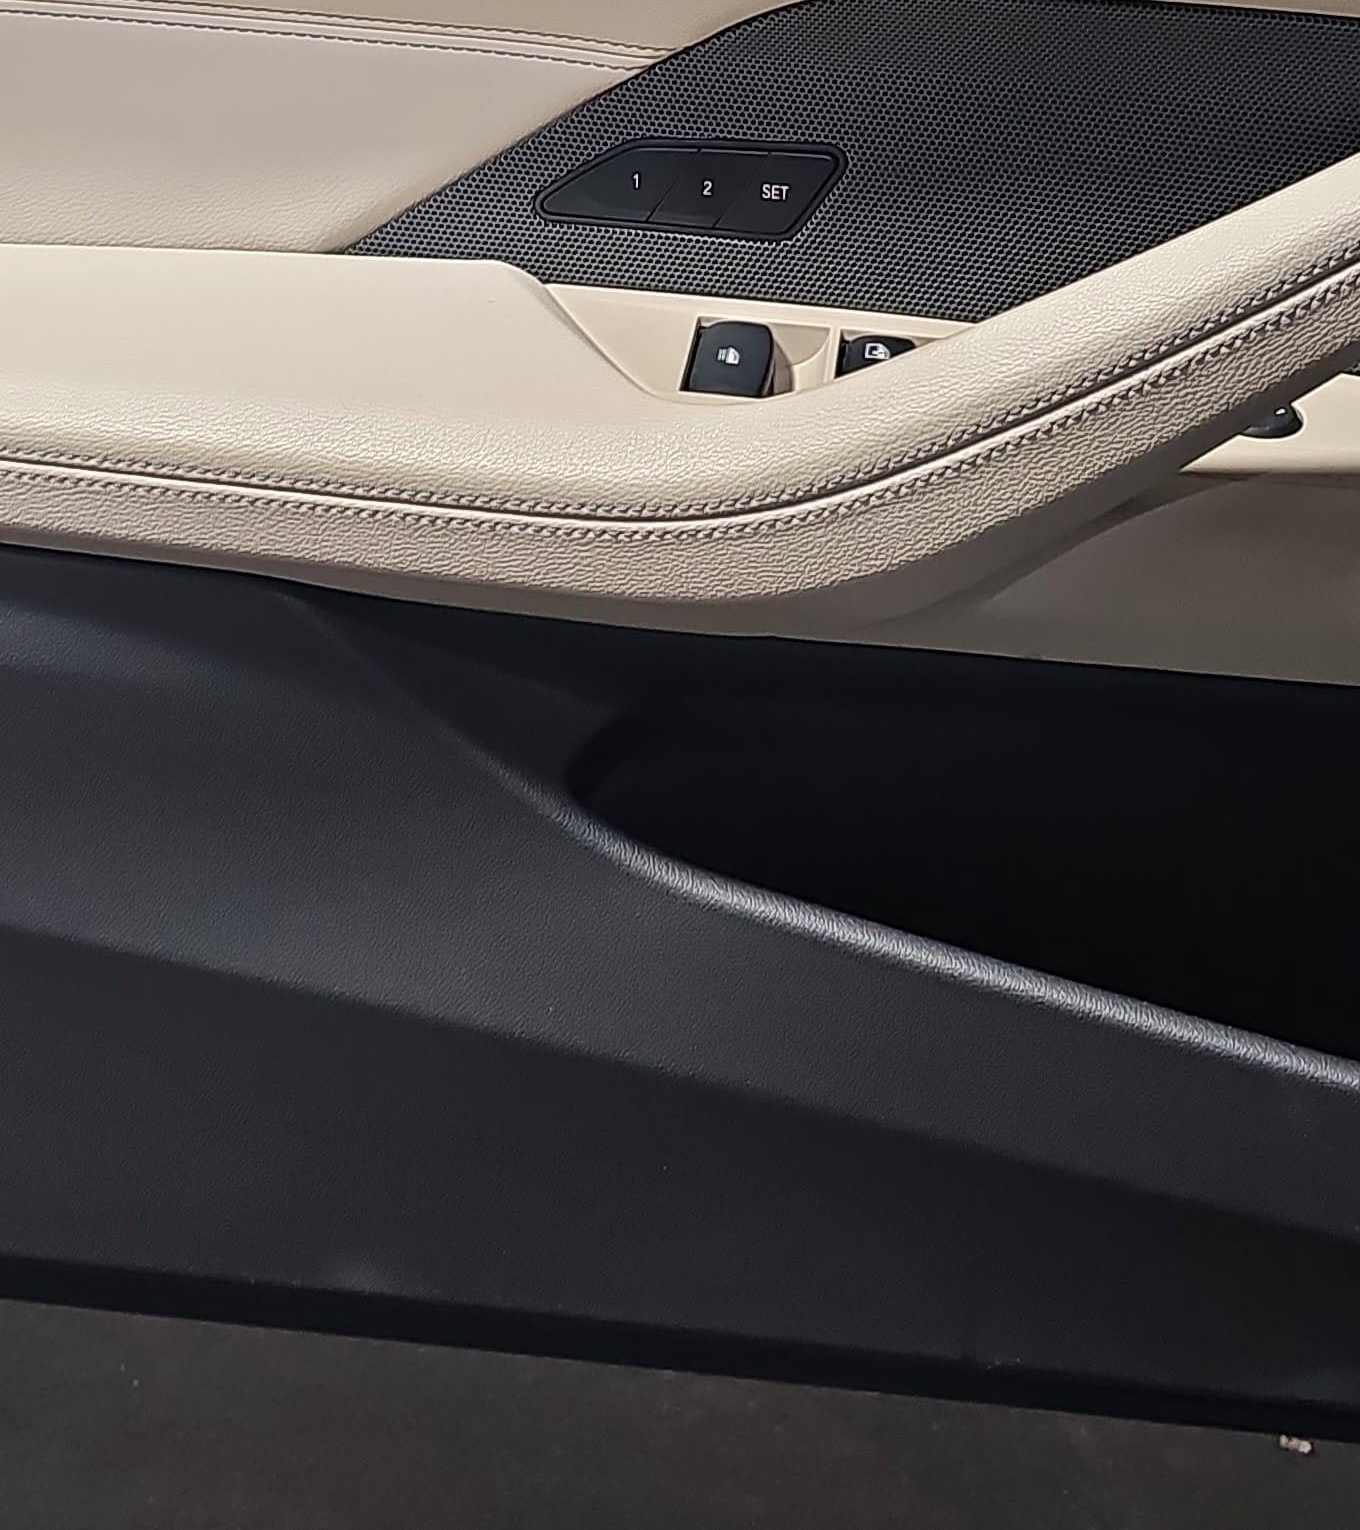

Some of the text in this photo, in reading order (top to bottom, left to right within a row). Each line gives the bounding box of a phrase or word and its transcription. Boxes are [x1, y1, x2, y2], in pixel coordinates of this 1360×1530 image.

[632, 173, 790, 201] 1 2 SET
